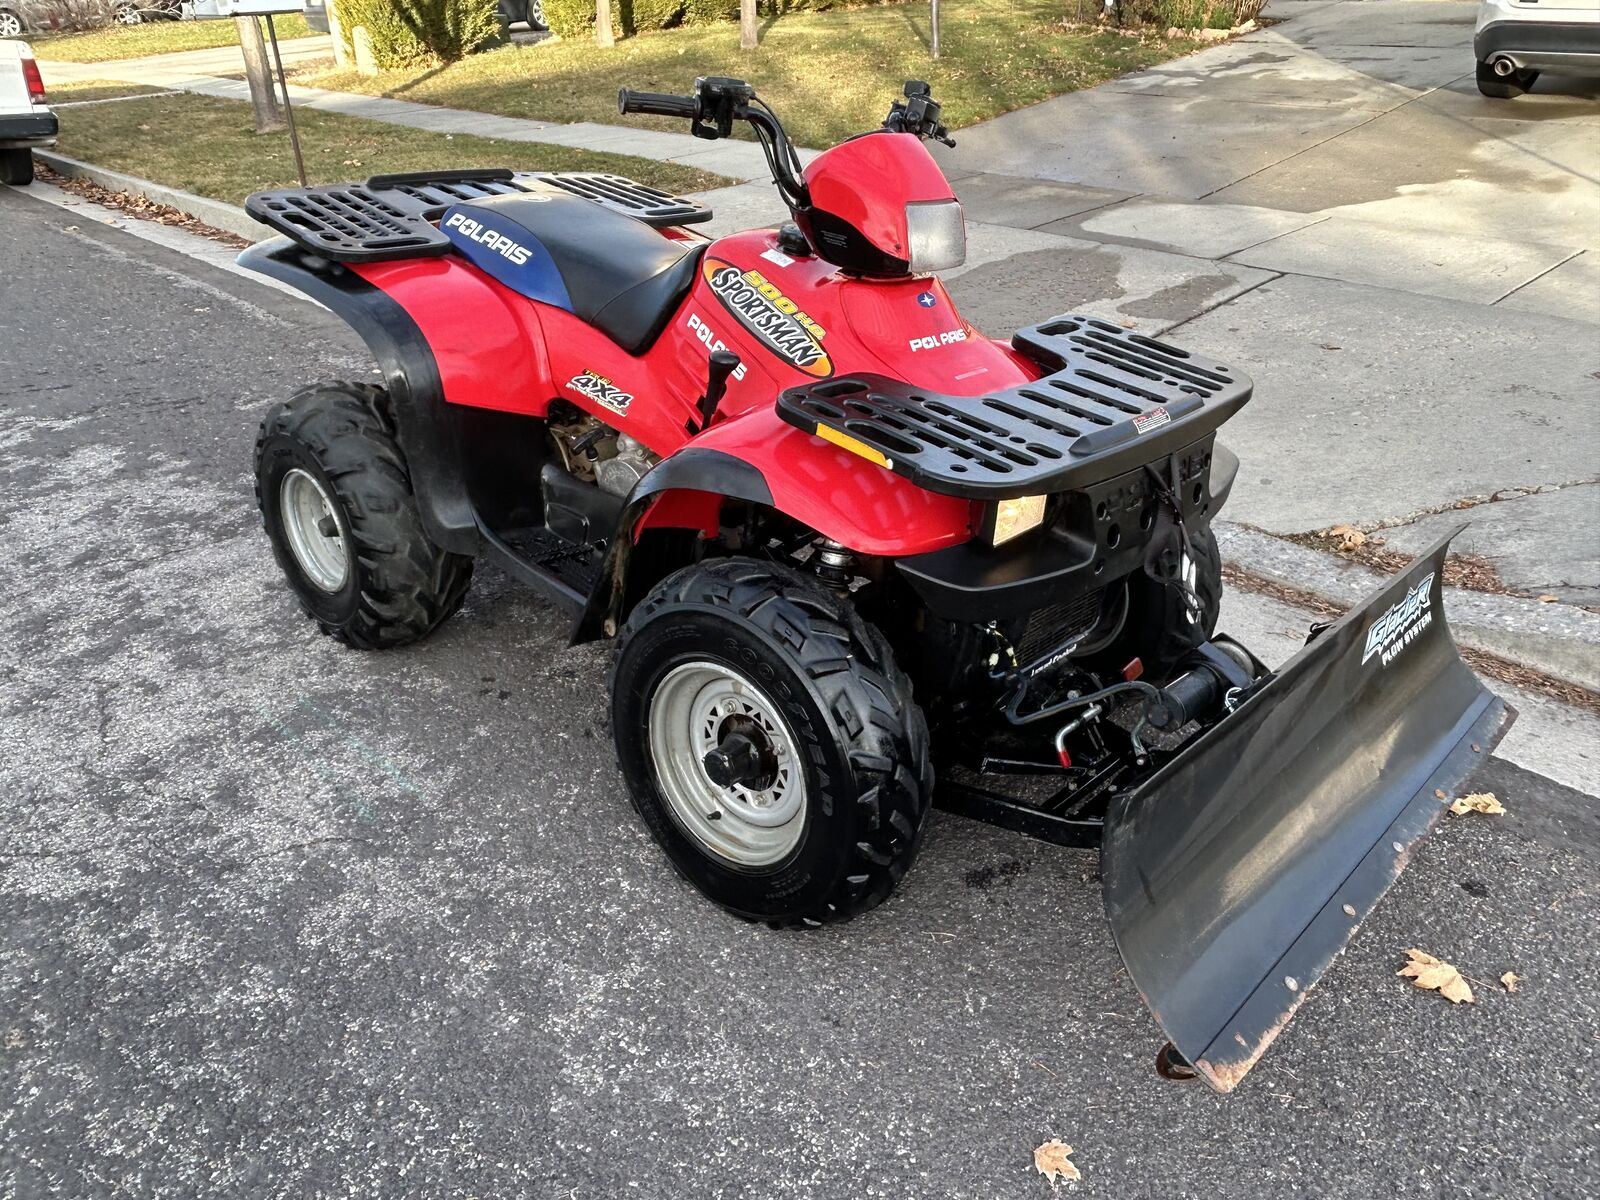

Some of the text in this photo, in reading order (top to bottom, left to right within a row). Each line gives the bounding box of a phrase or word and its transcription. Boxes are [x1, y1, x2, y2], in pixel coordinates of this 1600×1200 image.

[445, 213, 533, 265] POLARIS
[710, 267, 827, 366] SPORTSMAN
[741, 269, 798, 315] 500
[909, 328, 967, 352] POLARIS
[1382, 610, 1432, 667] PLOW SYSTEM
